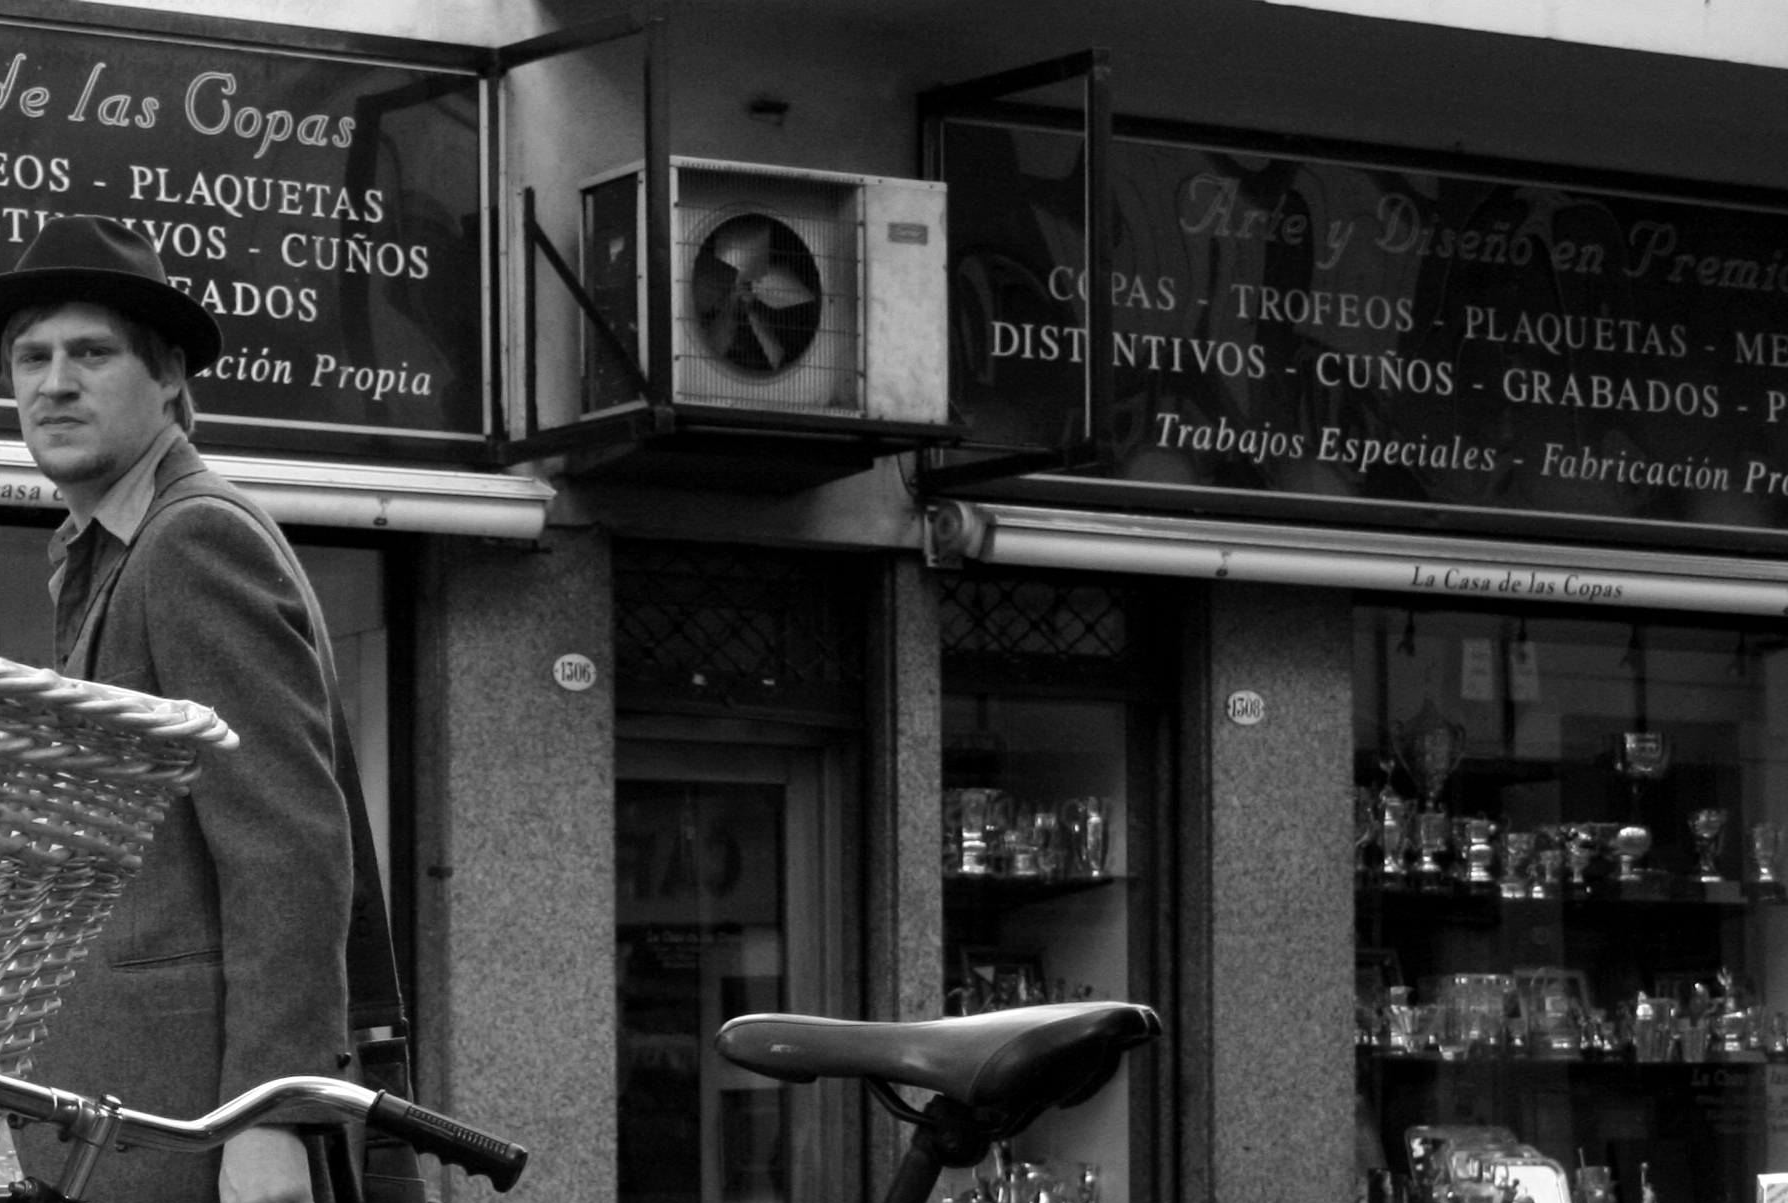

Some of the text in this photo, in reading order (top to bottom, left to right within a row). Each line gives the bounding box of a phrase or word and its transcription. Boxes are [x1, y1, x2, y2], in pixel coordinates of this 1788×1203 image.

[68, 62, 160, 129] las
[184, 71, 357, 159] Copas
[129, 165, 384, 223] PLAQUETAS
[1179, 173, 1308, 246] Arte
[1316, 216, 1355, 270] y
[1374, 192, 1533, 266] Diseño
[1551, 239, 1605, 275] en
[281, 232, 430, 280] CUÑOS
[1231, 284, 1414, 333] TROFEOS
[1464, 305, 1687, 357] PLAQUETAS
[310, 353, 433, 401] Propia
[990, 320, 1266, 379] DISTNTIVOS
[1315, 350, 1453, 396] CUÑOS
[1502, 368, 1720, 418] GRABADOS
[1156, 413, 1304, 464] Trabajos
[1317, 427, 1496, 473] Especiales
[1540, 442, 1730, 491] Fabricación
[1412, 566, 1624, 601] La Casa de las Copas
[561, 660, 592, 684] 1306
[1232, 697, 1262, 718] 1308
